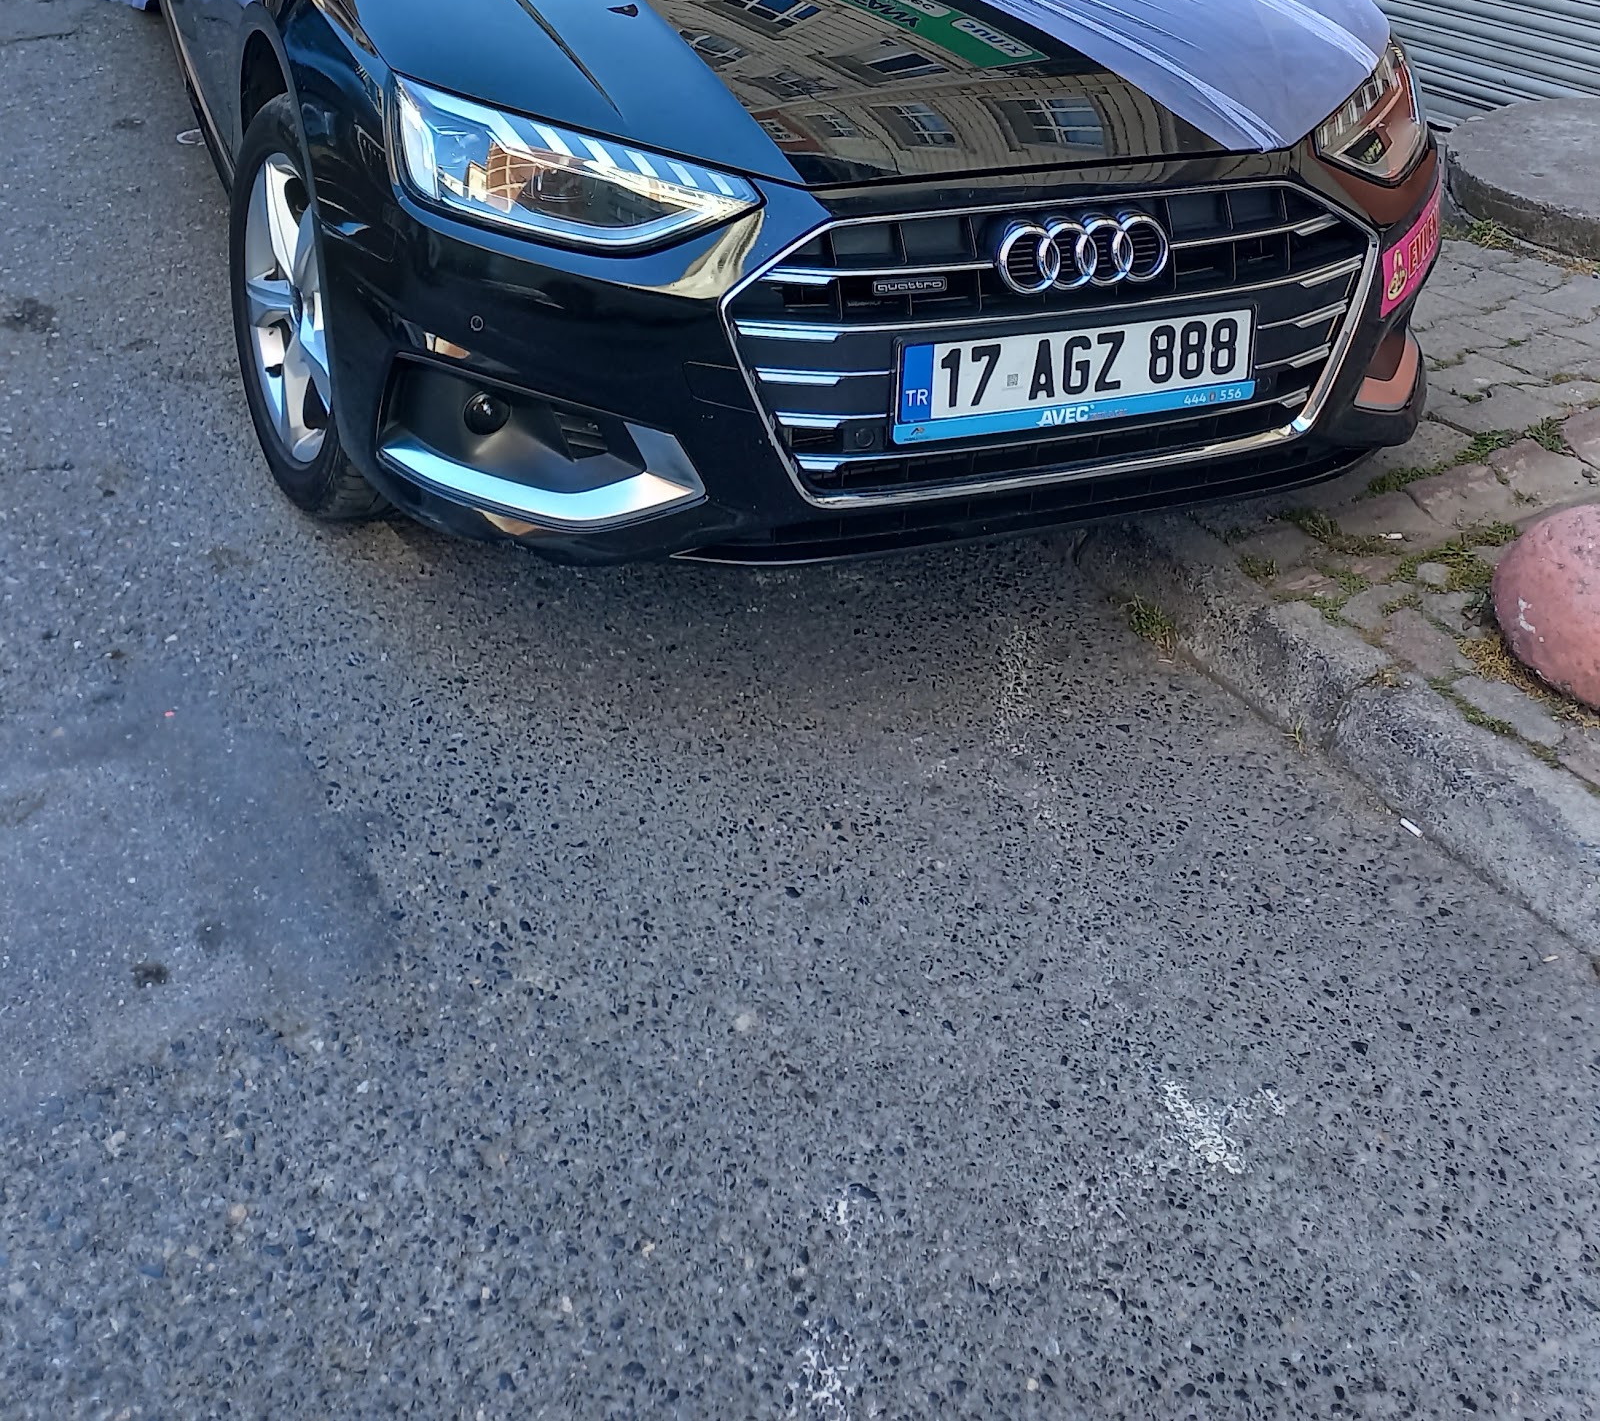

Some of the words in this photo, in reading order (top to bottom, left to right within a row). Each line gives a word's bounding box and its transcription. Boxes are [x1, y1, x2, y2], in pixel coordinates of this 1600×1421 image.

[877, 281, 942, 293] quattro
[940, 343, 1002, 408] 17
[1028, 330, 1125, 401] AGZ
[1149, 317, 1238, 384] 888
[905, 388, 928, 407] TR
[1036, 405, 1091, 428] AVEC
[1183, 393, 1207, 406] 444
[1219, 388, 1242, 400] 556
